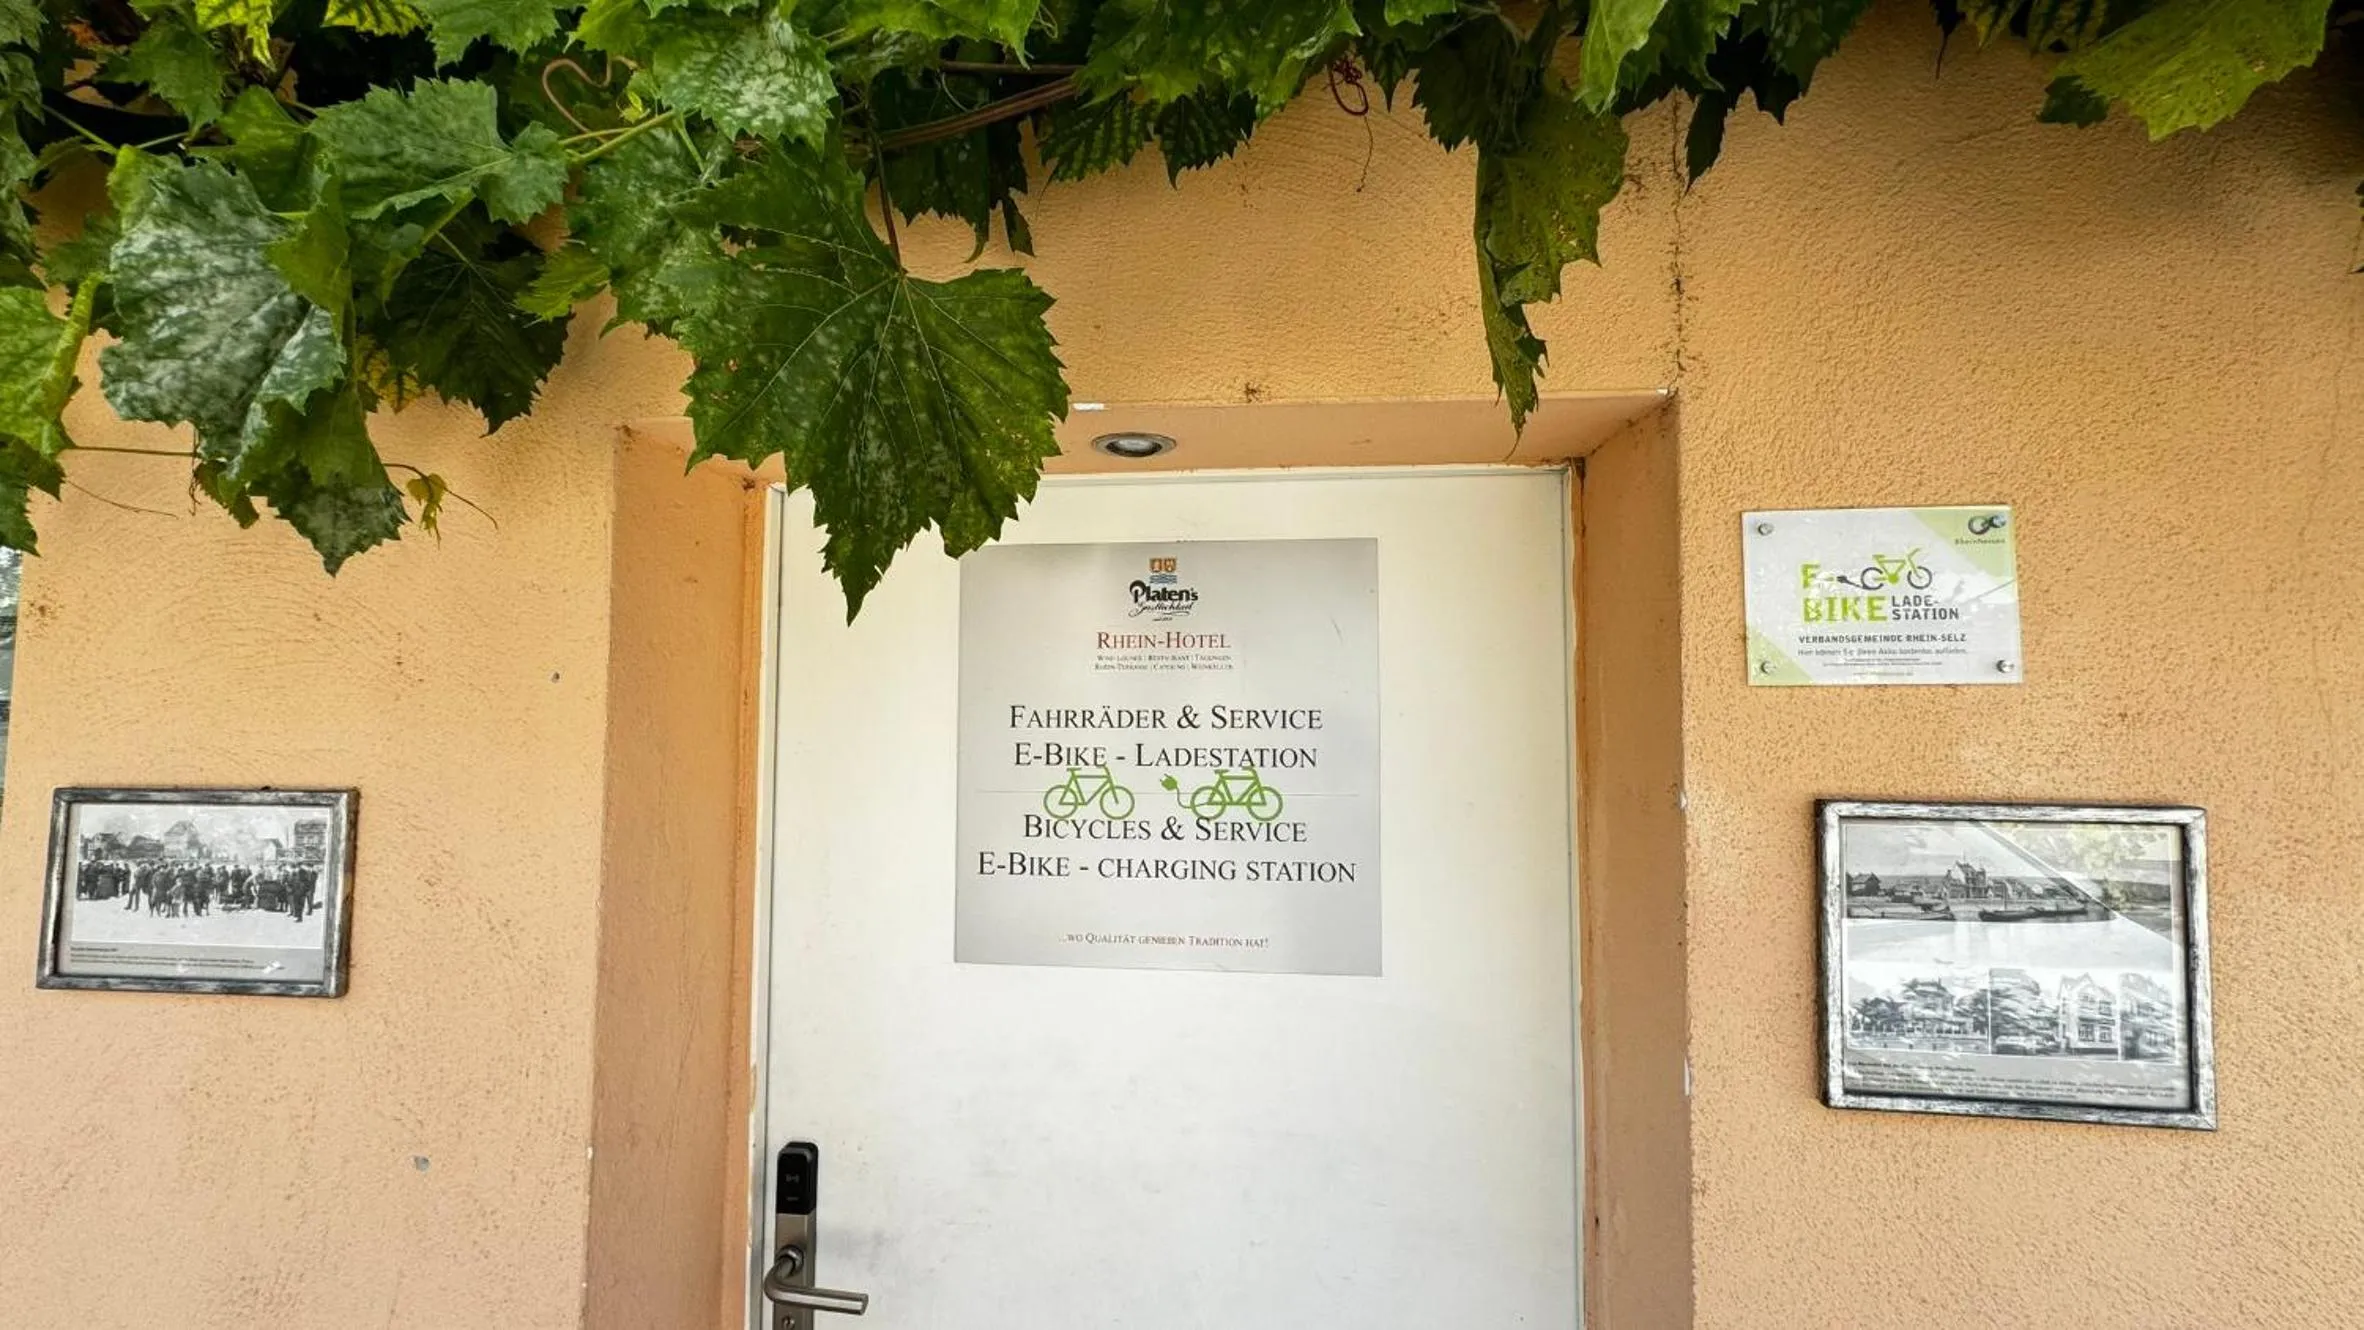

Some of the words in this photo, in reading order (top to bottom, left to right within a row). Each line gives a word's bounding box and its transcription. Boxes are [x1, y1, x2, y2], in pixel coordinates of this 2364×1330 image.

[1129, 580, 1199, 603] Platen's
[1803, 596, 1888, 622] BIKE
[1891, 595, 1939, 608] LADE-
[1891, 608, 1960, 621] STATION
[1097, 632, 1232, 649] RHEIN-HOTEL
[1798, 633, 1902, 644] VERBANDSGEMEINDE
[1906, 633, 1968, 643] RHEIN-SELZ
[1009, 705, 1167, 730] FAHRRÄDER
[1176, 705, 1201, 729] &
[1211, 706, 1323, 729] SERVICE
[1014, 743, 1107, 767] E-BIKE
[1136, 744, 1318, 768] LADESTATION
[1024, 815, 1151, 840] BICYCLES
[1161, 816, 1185, 841] &
[1195, 818, 1307, 842] SERVICE
[978, 852, 1070, 877] E-BIKE
[1097, 858, 1237, 880] CHARGING
[1246, 860, 1356, 883] STATION
